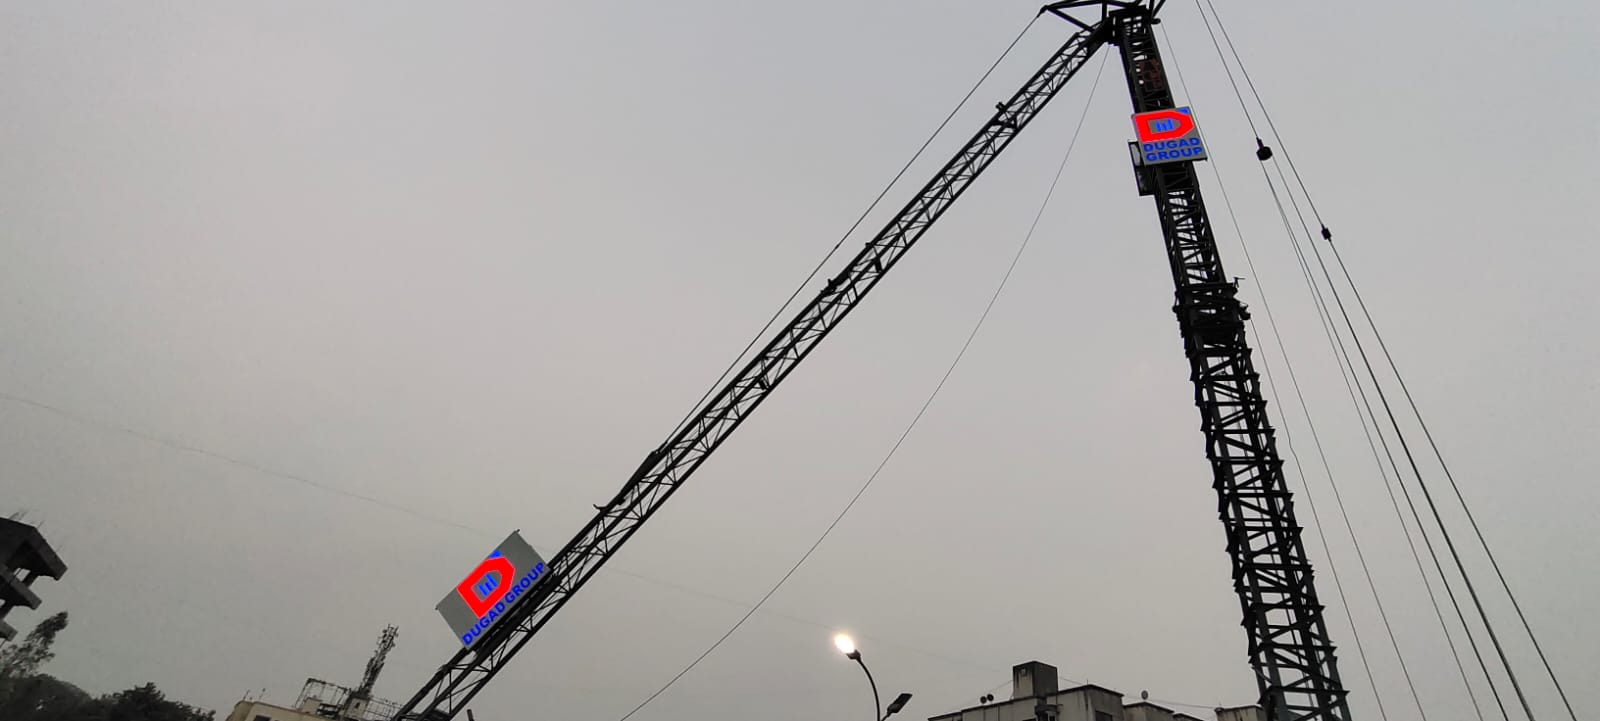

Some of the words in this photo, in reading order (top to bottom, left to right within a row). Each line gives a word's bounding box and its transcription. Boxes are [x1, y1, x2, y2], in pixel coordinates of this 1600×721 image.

[1143, 138, 1200, 152] DUGAD
[1146, 147, 1203, 161] GROUP
[462, 601, 505, 645] DUGAD
[504, 562, 544, 604] GROUP
